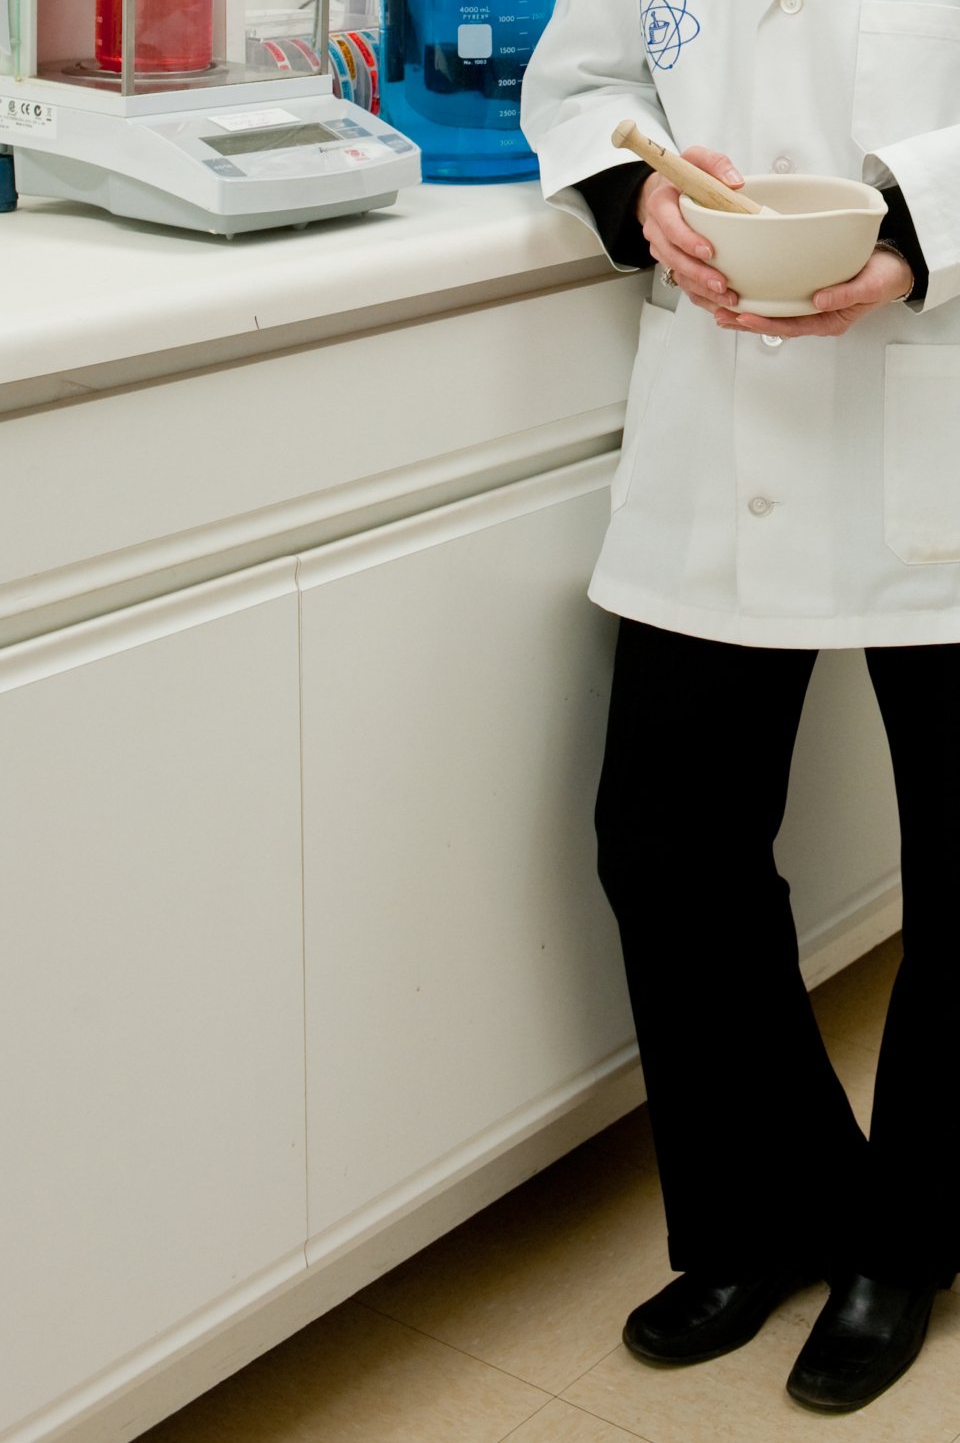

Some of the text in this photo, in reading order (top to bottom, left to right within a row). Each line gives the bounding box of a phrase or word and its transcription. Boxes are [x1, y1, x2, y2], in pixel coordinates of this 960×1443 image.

[500, 46, 516, 54] 1500
[498, 79, 516, 87] 2000
[499, 109, 516, 118] 2500
